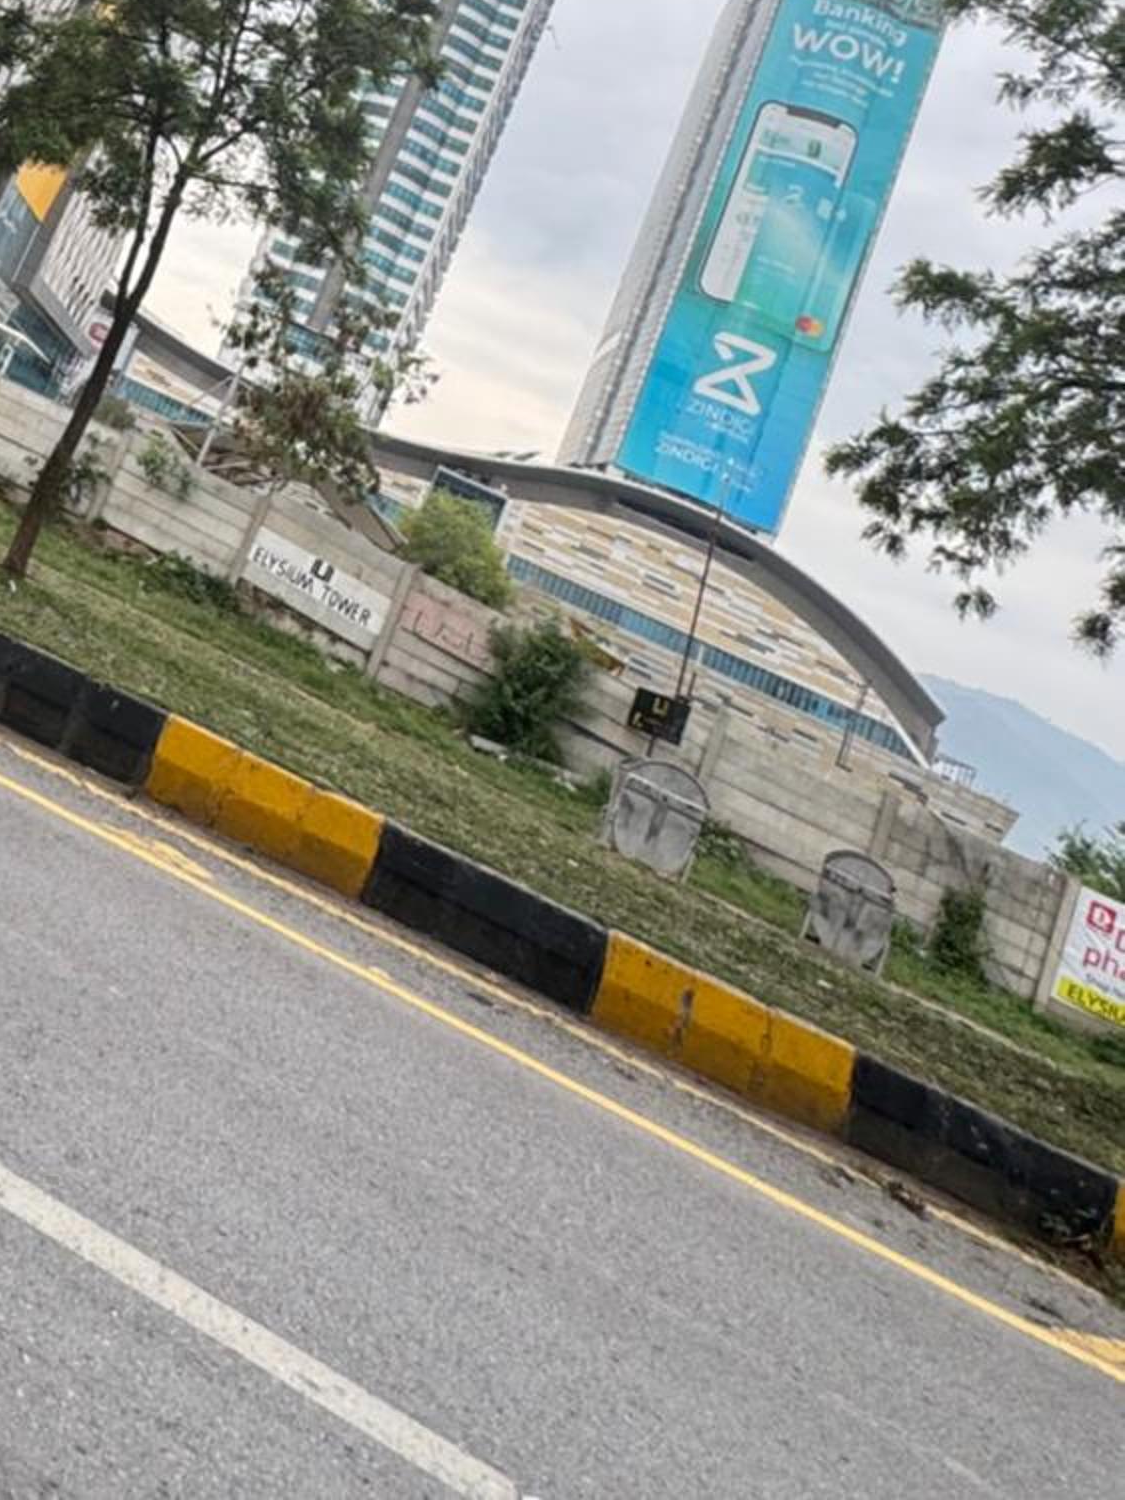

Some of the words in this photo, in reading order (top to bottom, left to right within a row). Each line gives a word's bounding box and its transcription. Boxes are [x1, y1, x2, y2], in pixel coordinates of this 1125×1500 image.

[794, 23, 905, 84] WOW!
[251, 547, 314, 592] ELYSIUM
[321, 585, 372, 627] TOWER
